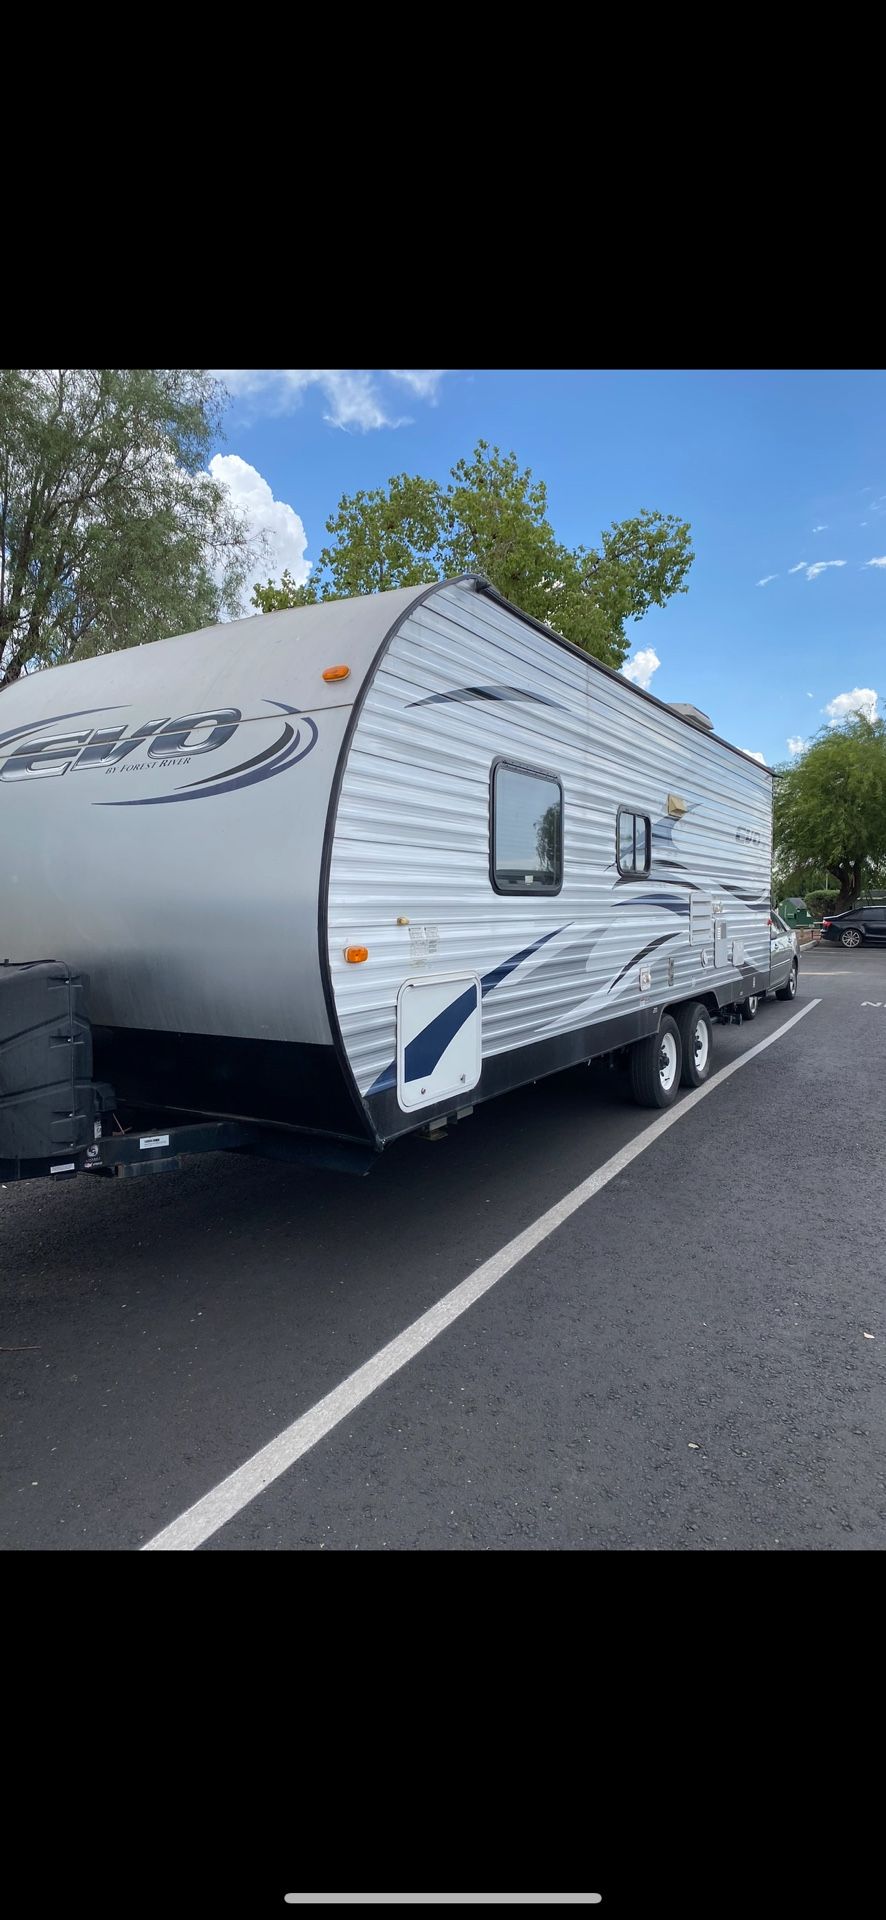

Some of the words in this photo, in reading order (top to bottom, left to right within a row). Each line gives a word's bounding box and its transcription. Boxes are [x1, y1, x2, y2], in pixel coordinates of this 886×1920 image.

[0, 708, 242, 782] EVO
[105, 766, 117, 775] BY
[120, 762, 157, 773] FOREST
[159, 757, 192, 768] RIVER
